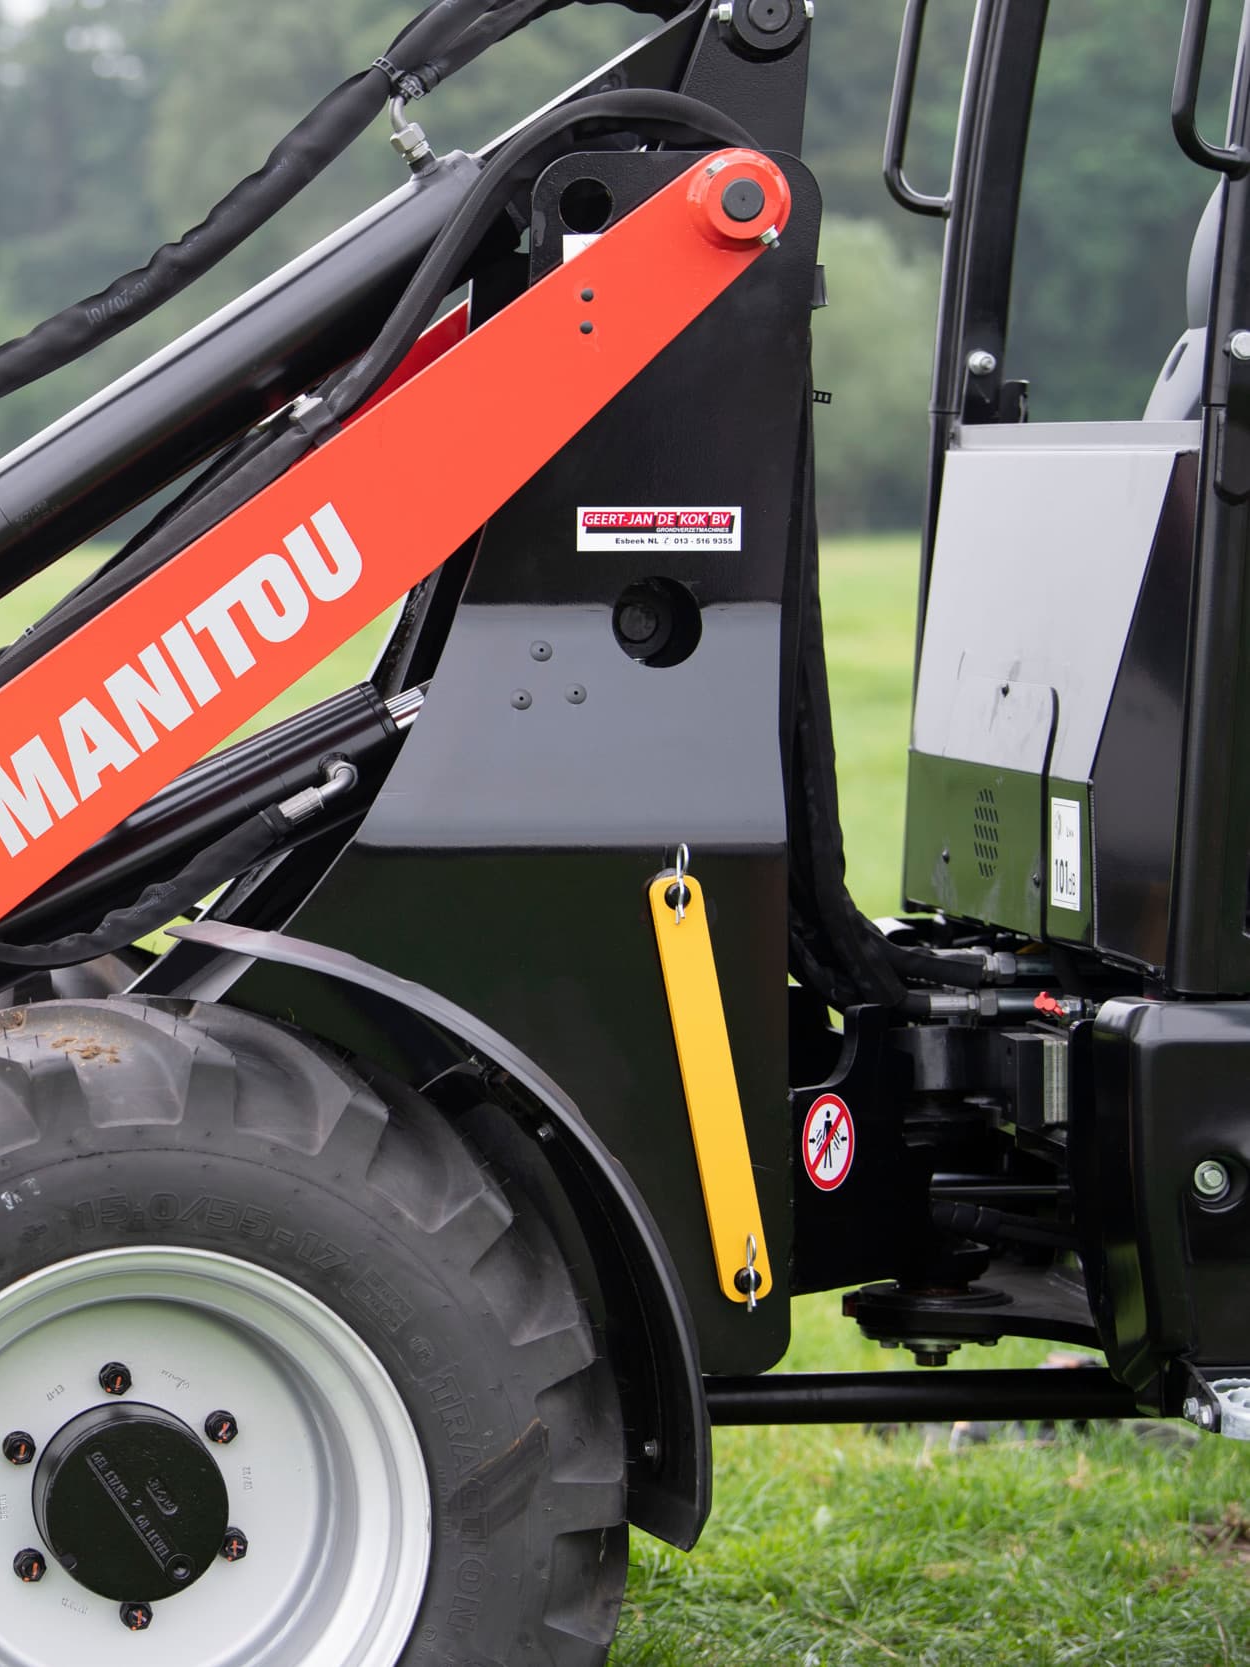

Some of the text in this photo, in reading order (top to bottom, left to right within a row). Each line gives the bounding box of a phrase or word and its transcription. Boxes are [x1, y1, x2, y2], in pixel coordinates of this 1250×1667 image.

[584, 513, 730, 526] GEERT-JAN DE KOK BV
[615, 537, 645, 545] Esbeek
[647, 537, 659, 545] NL
[674, 537, 689, 545] 013
[696, 537, 710, 545] 516
[712, 537, 733, 545] 9355
